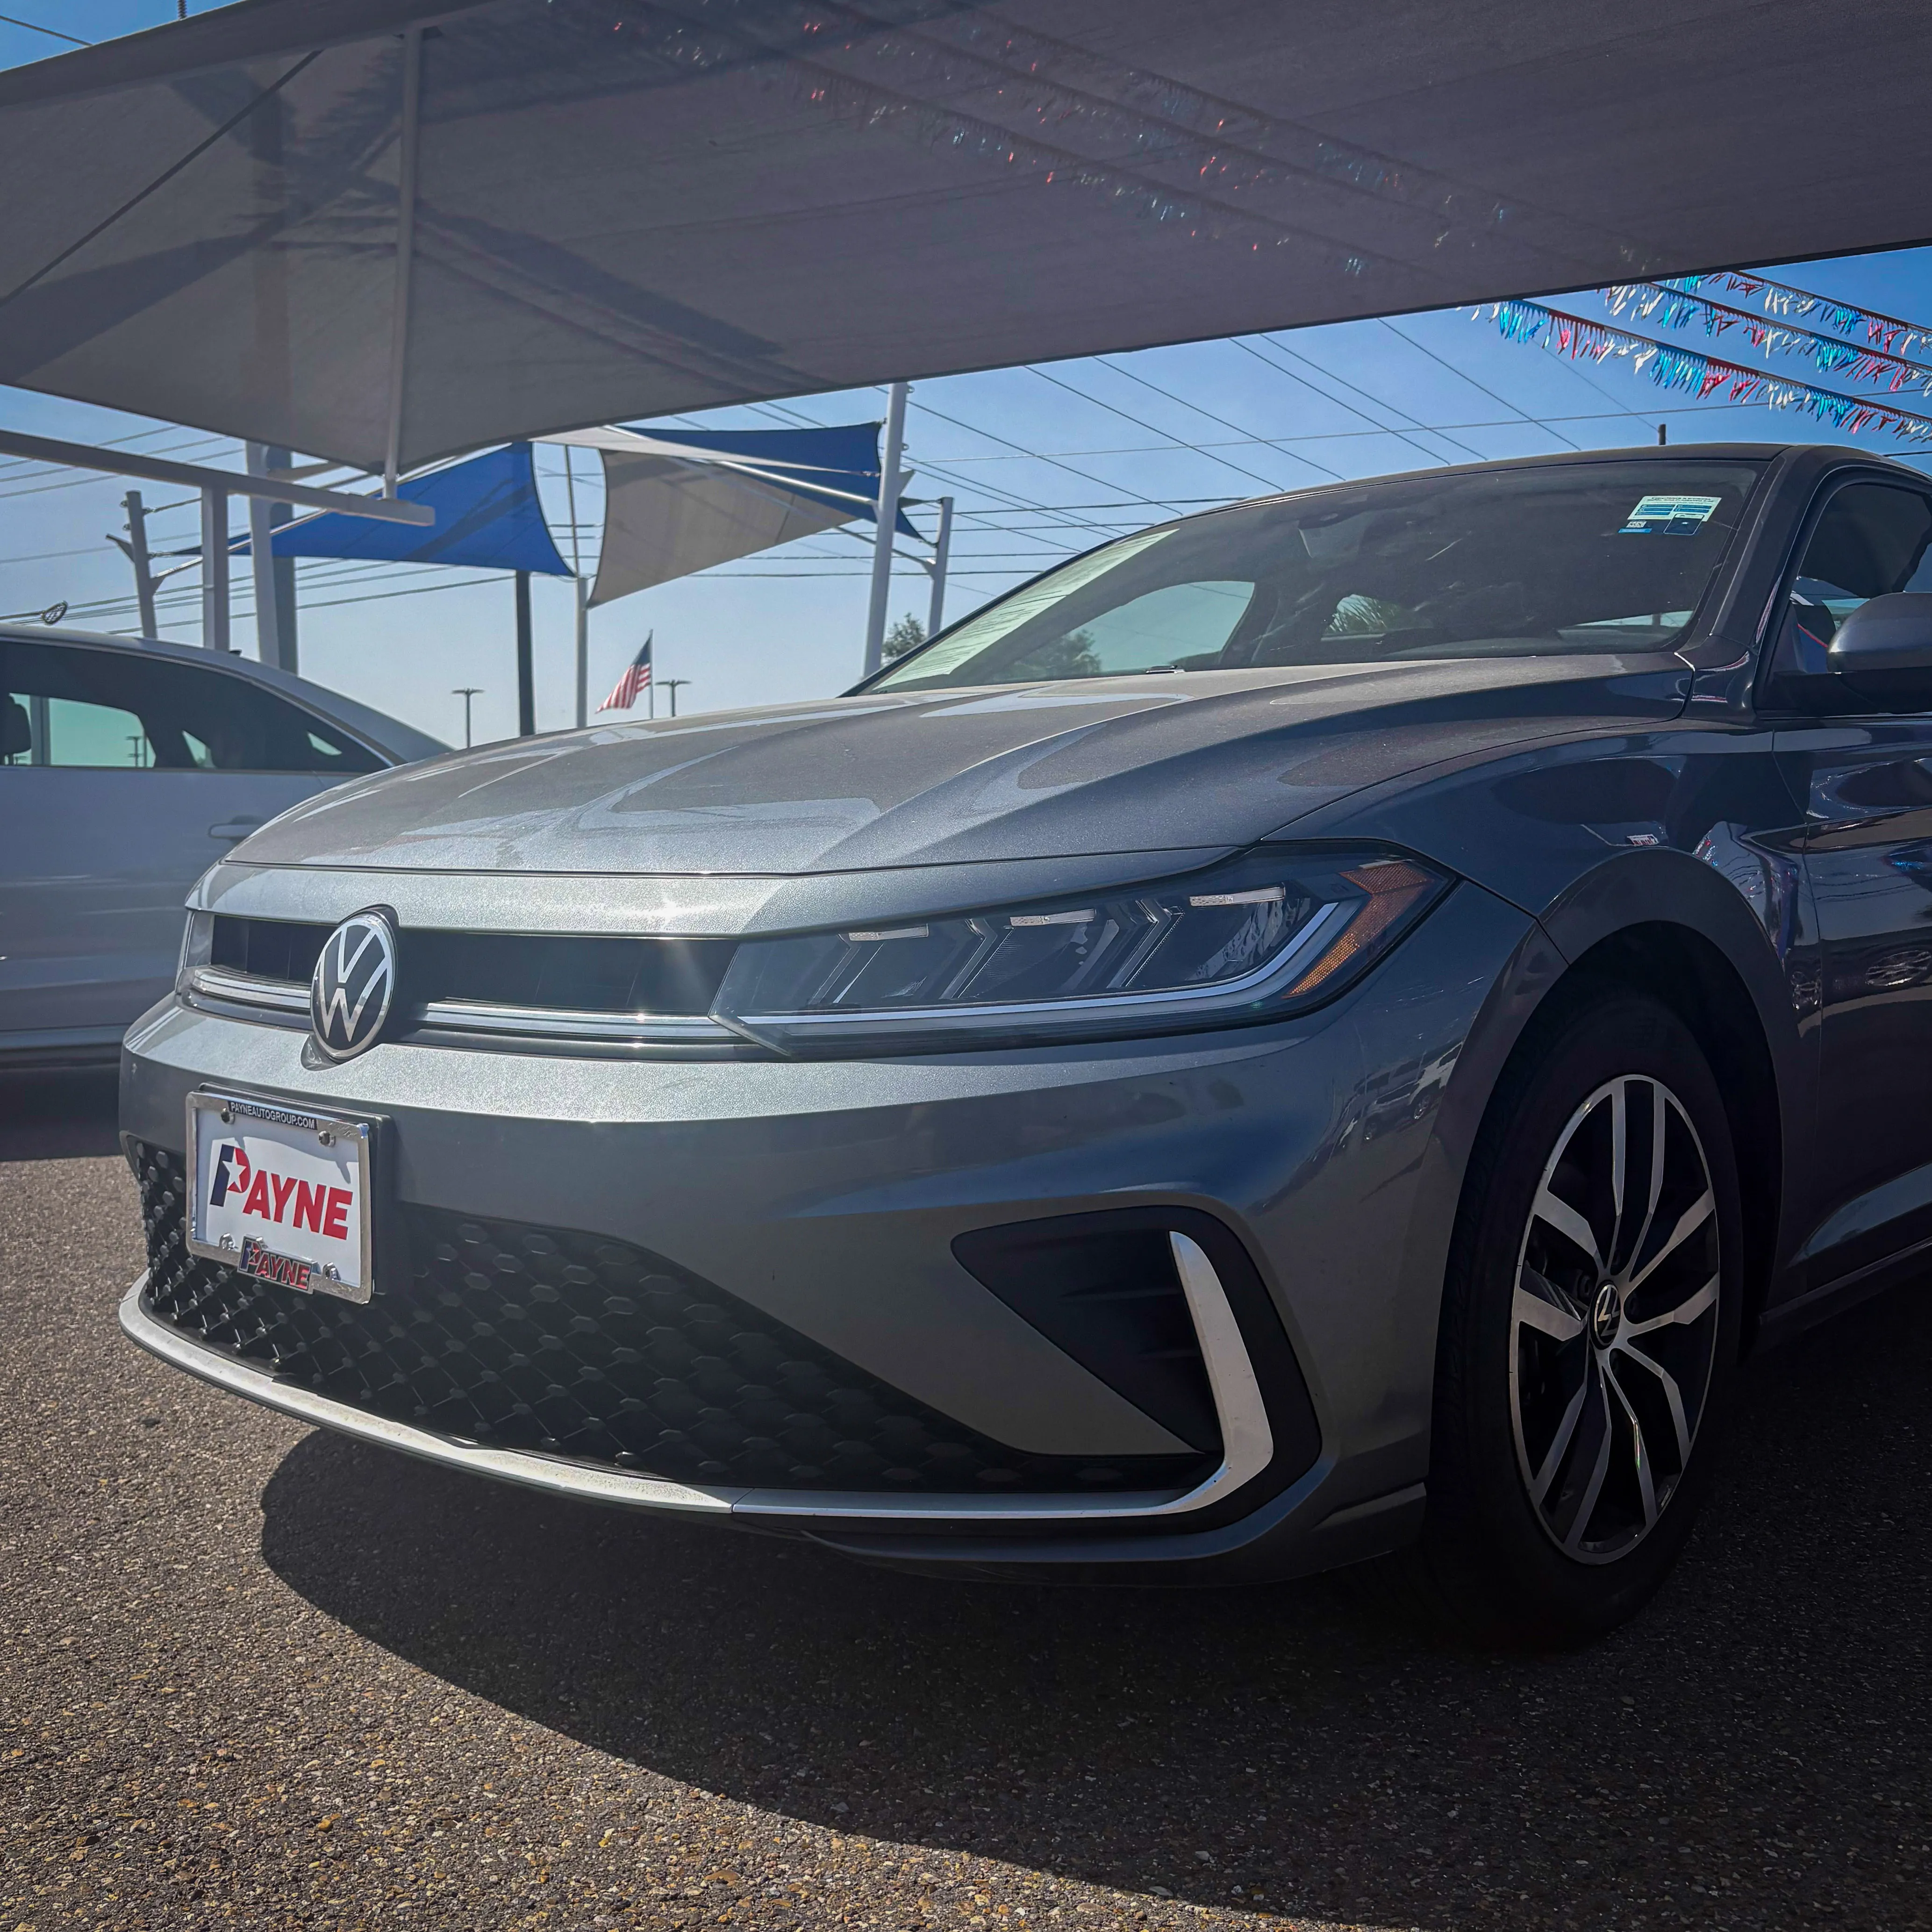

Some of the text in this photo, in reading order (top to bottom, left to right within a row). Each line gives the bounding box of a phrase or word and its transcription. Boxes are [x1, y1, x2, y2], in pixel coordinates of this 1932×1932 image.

[230, 1102, 315, 1129] PAYNEAUTOGROUP.COM
[209, 1144, 353, 1241] PAYNE
[239, 1239, 311, 1290] PAYNE
